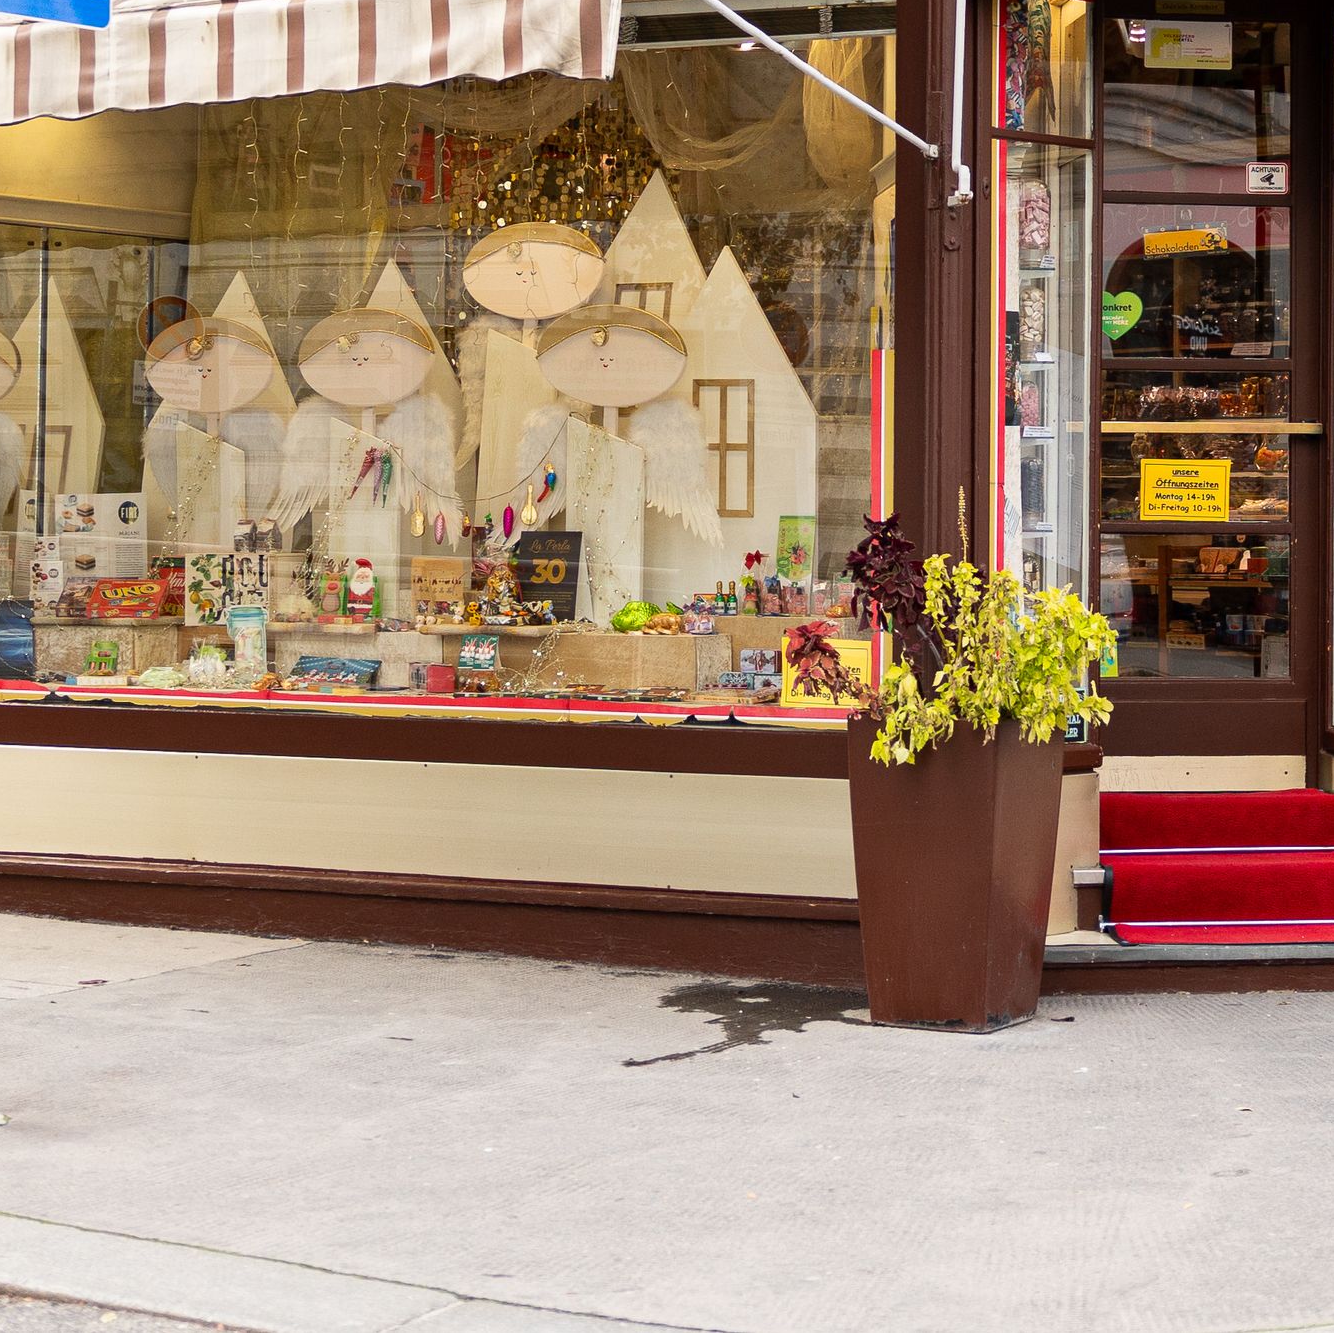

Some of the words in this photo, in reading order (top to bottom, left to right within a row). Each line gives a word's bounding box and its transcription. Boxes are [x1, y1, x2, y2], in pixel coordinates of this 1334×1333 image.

[1145, 243, 1200, 254] Schokoladen
[1103, 303, 1132, 312] onkret
[1155, 478, 1219, 489] Öffnungszeiten
[1155, 493, 1183, 502] Montag
[1148, 503, 1189, 513] Di-Freitag
[530, 558, 566, 584] 30
[101, 583, 161, 600] UNO
